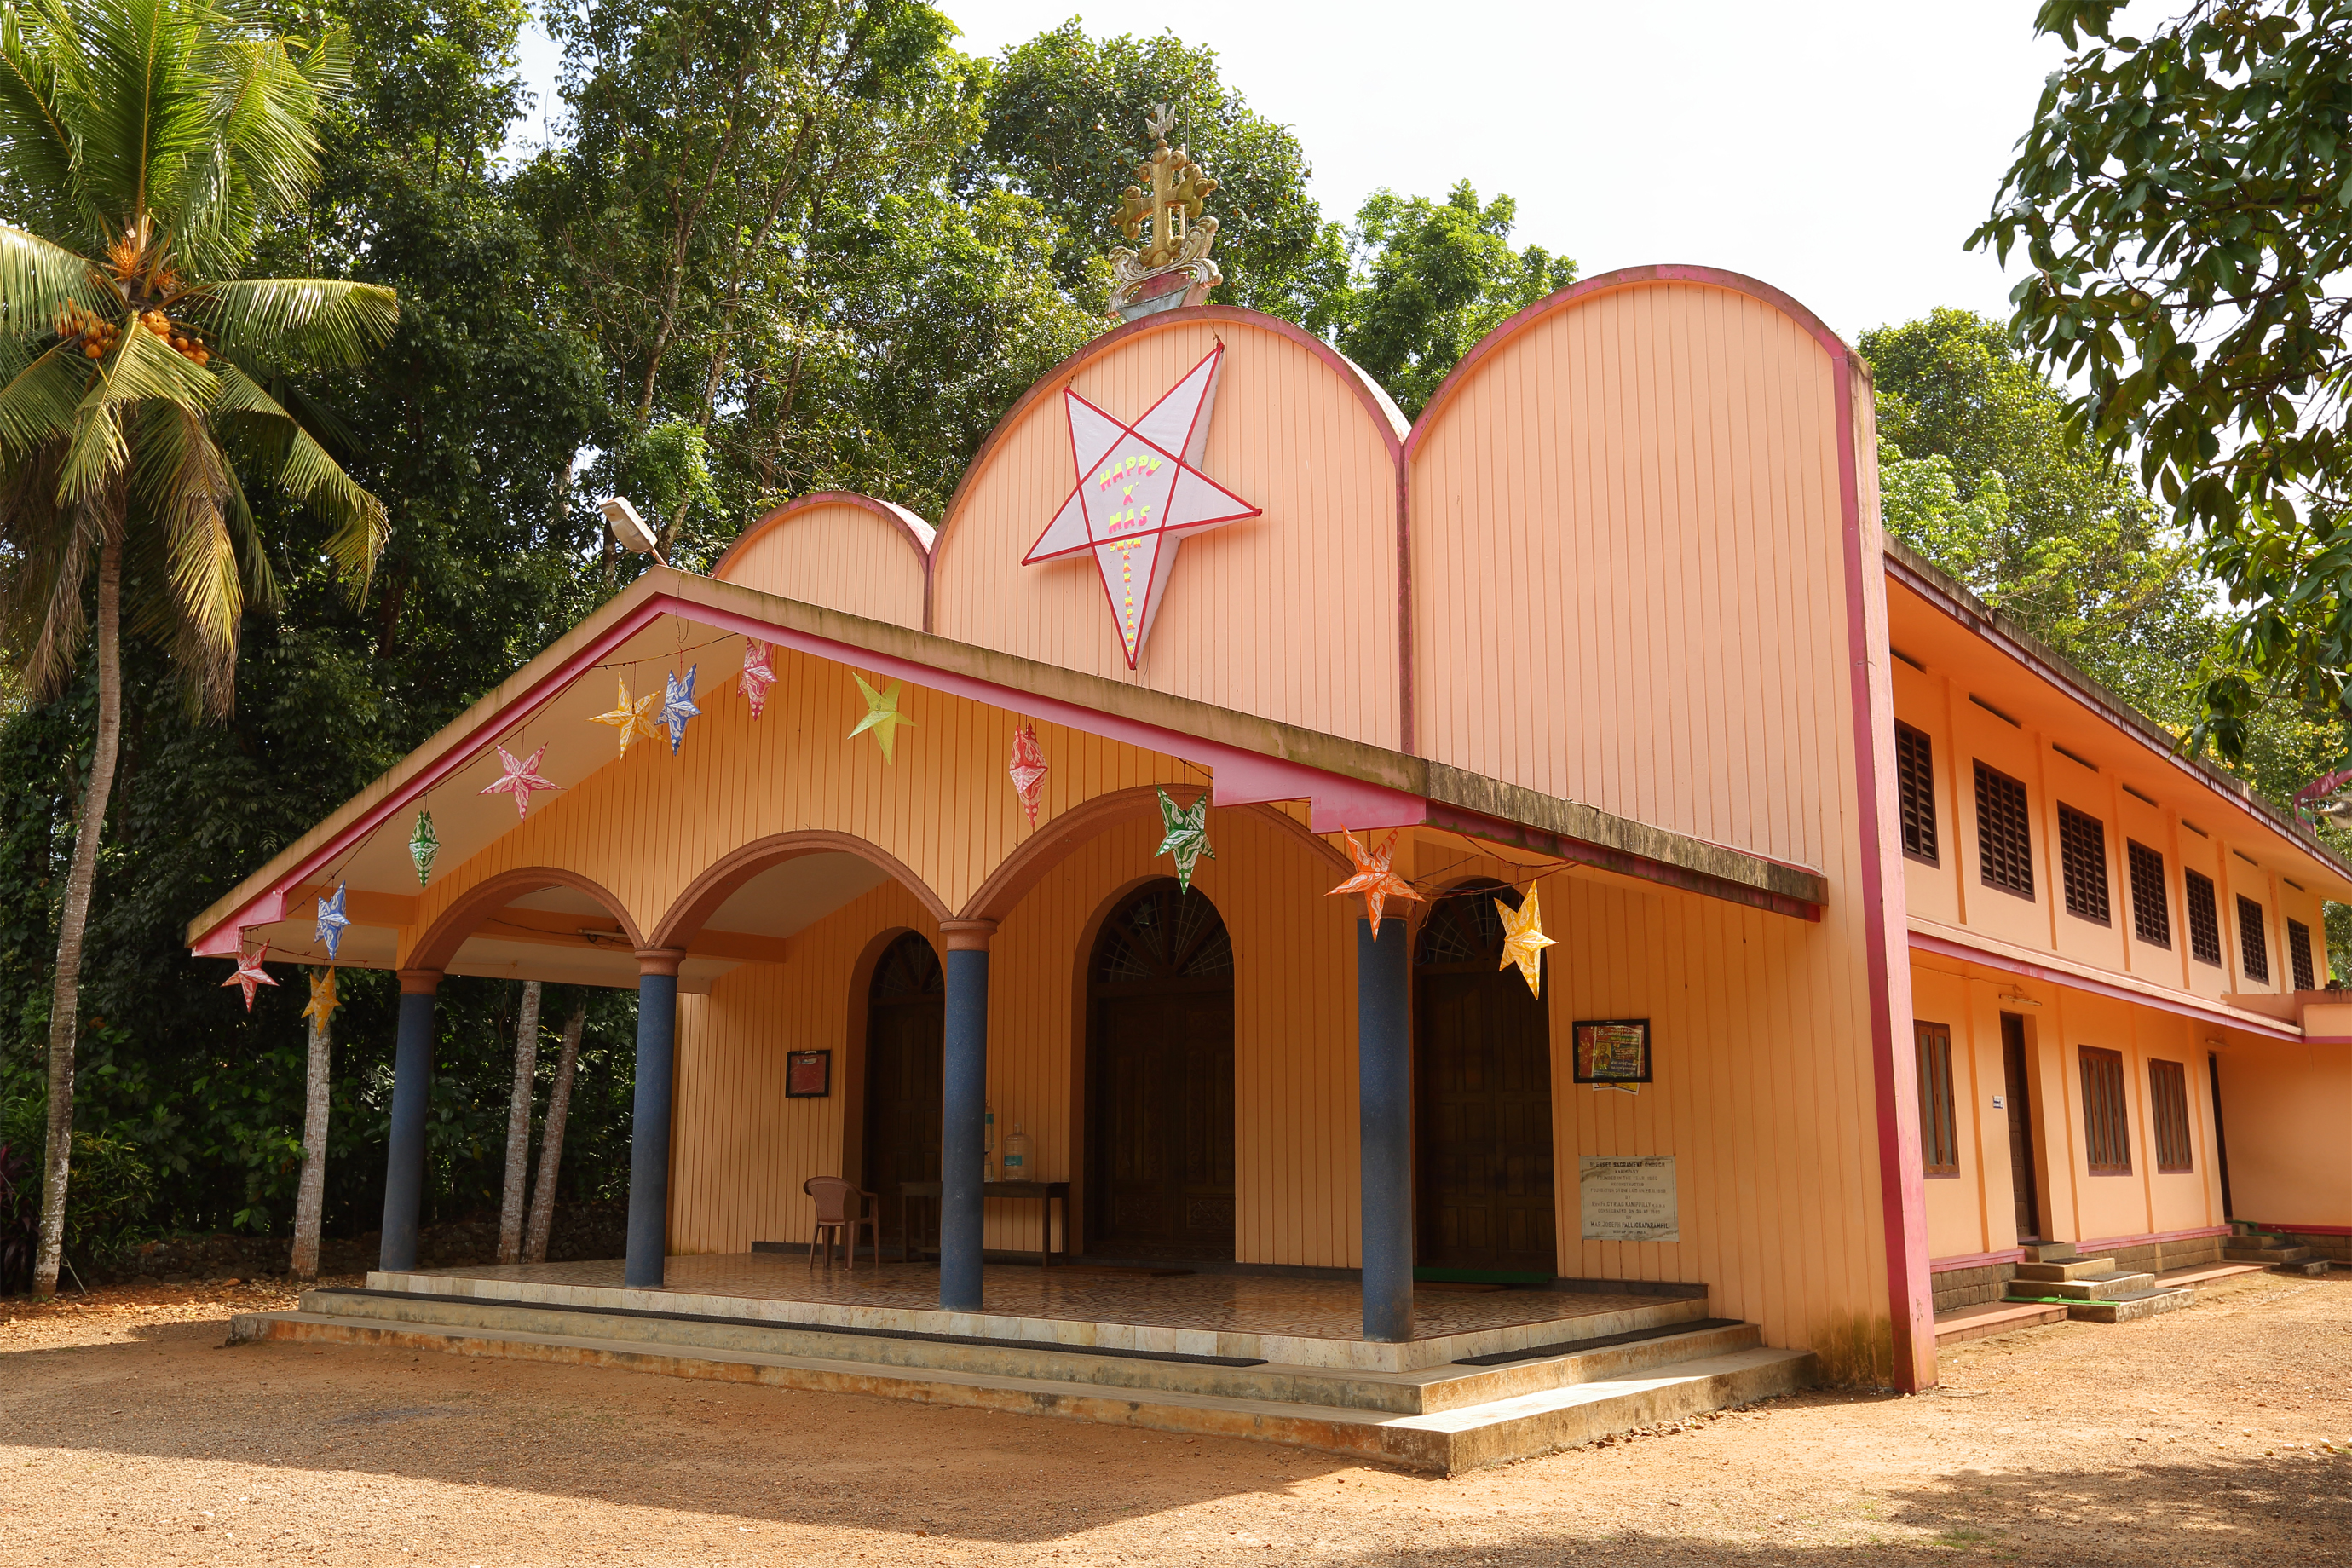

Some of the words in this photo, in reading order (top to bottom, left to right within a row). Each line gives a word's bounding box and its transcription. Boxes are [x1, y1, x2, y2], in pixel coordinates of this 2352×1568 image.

[1100, 454, 1162, 492] HAPPY
[1109, 505, 1150, 534] MAS
[1110, 539, 1142, 551] SMYM
